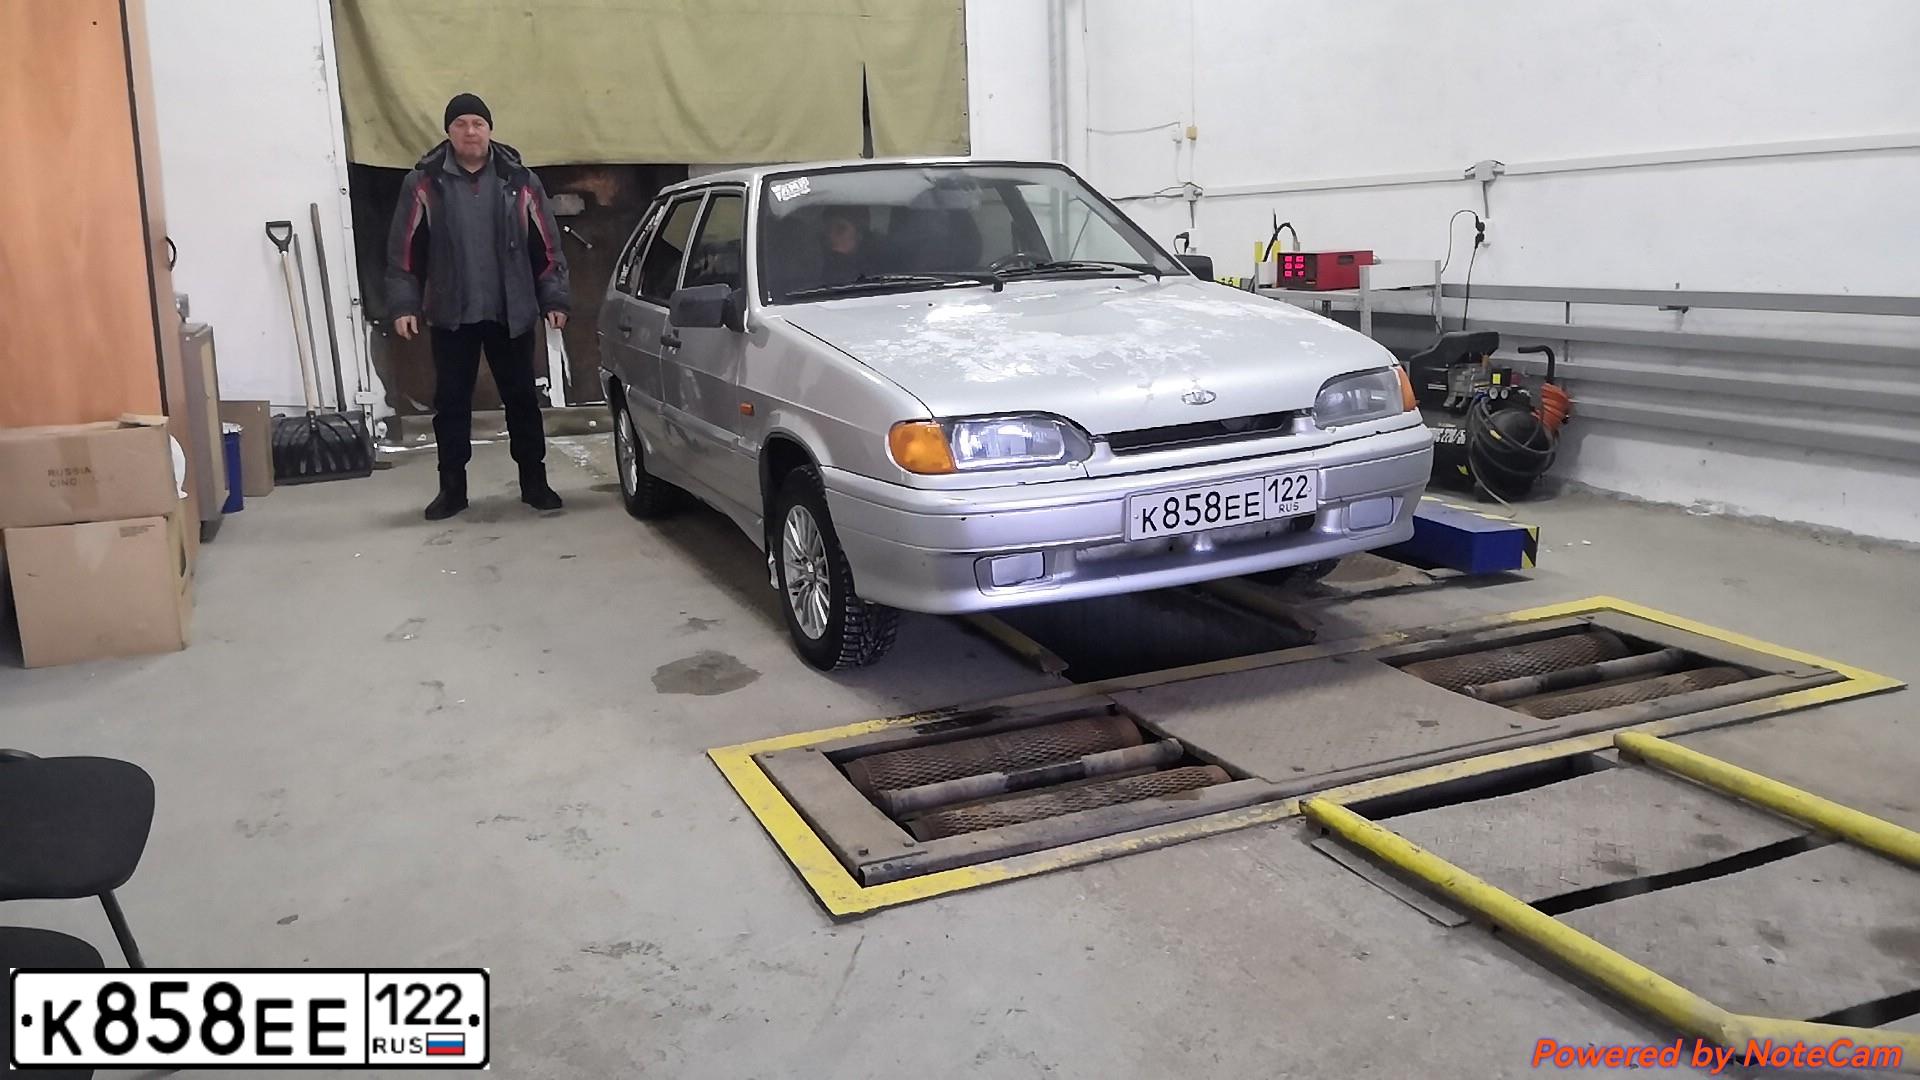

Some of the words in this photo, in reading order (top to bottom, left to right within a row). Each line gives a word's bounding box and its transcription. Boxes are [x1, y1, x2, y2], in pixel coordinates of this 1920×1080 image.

[47, 466, 92, 477] RUSSIA
[1267, 474, 1309, 504] 122
[1141, 491, 1260, 533] K858EE
[1278, 501, 1300, 514] RUS
